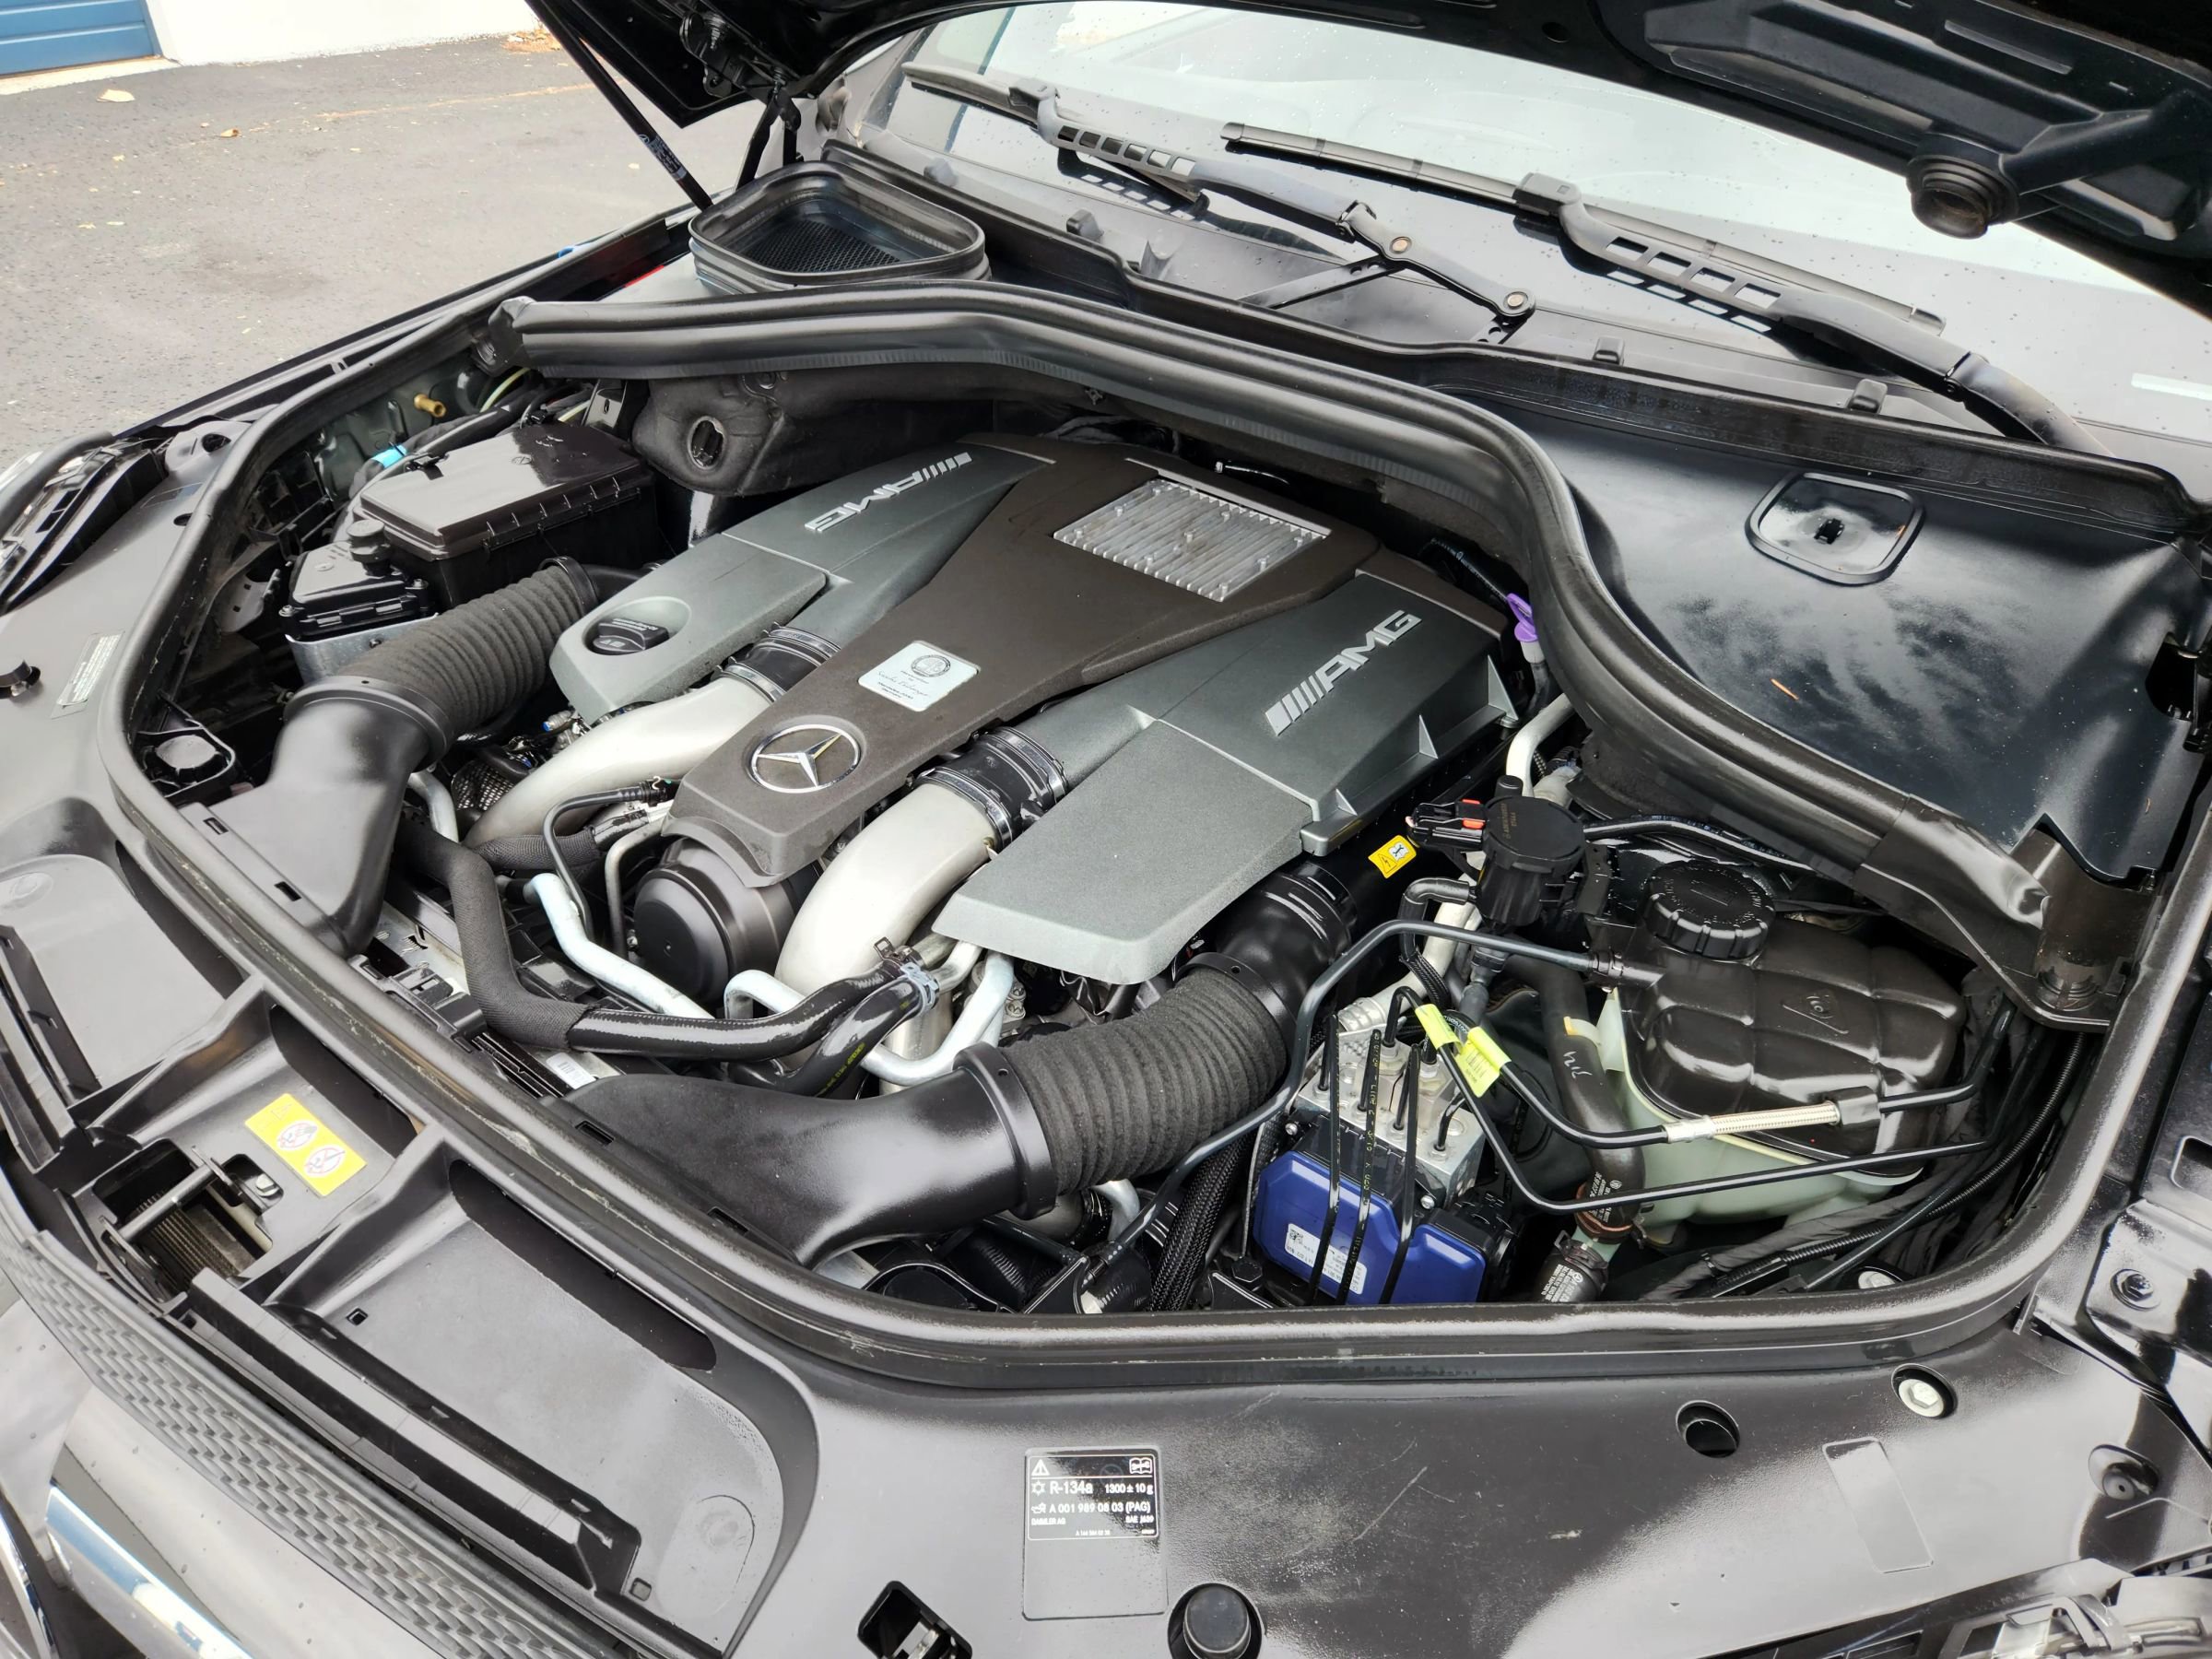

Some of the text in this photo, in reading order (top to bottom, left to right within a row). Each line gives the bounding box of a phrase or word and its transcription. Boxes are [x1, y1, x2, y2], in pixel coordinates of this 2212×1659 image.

[805, 471, 924, 532] AMG
[1315, 610, 1422, 692] AMG
[1050, 1480, 1093, 1494] R-134a
[1105, 1483, 1124, 1493] 1300
[1135, 1483, 1146, 1493] 10
[1147, 1485, 1154, 1495] g
[1049, 1504, 1057, 1513] A
[1058, 1503, 1076, 1512] 001
[1077, 1502, 1095, 1512] 989
[1111, 1501, 1124, 1512] 03
[1125, 1500, 1151, 1513] (PAG)
[1057, 1517, 1066, 1525] AG
[1125, 1515, 1138, 1524] SAE
